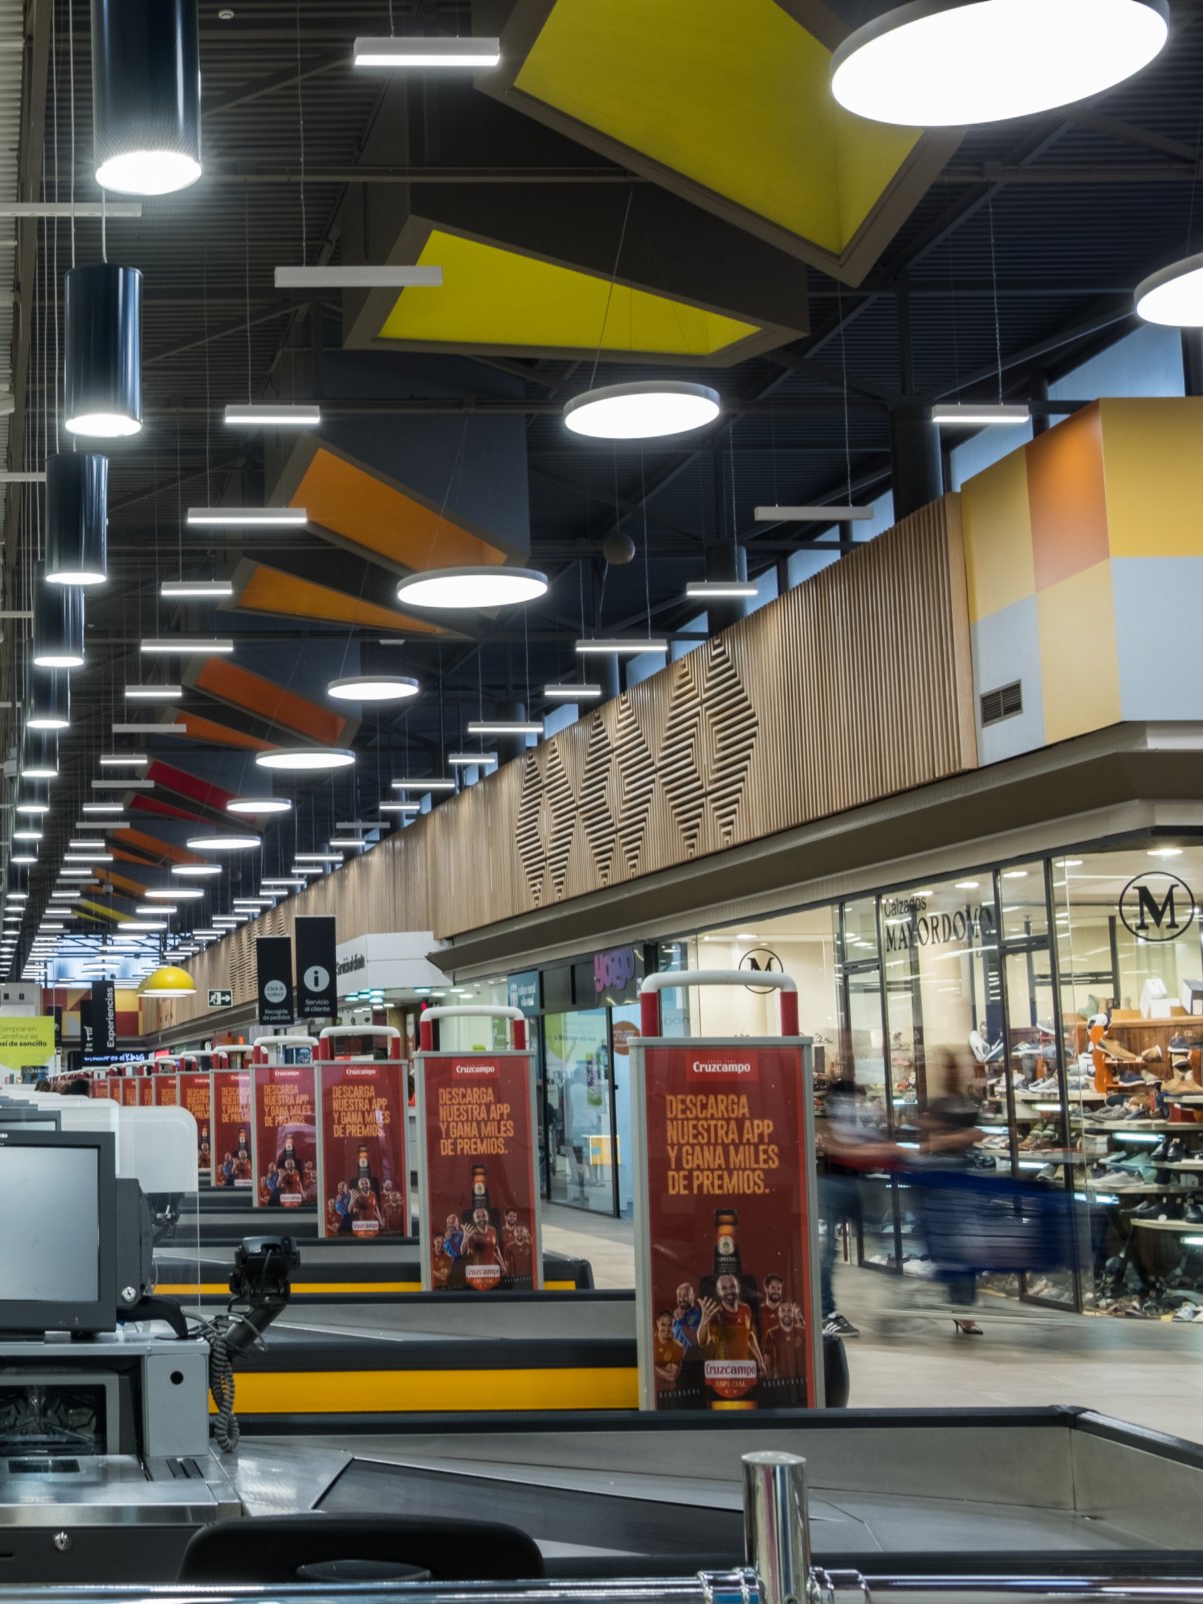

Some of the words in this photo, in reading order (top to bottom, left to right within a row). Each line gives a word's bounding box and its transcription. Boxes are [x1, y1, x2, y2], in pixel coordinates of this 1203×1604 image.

[884, 895, 926, 918] Calzados
[1132, 884, 1180, 930] M
[106, 987, 116, 1048] Experiencias
[456, 1066, 495, 1075] Cruzcampo
[693, 1061, 751, 1074] Cruzcampo
[264, 1084, 298, 1095] DESCARGA
[333, 1085, 375, 1099] DESCARGA
[439, 1088, 494, 1104] DESCARGA
[264, 1095, 295, 1105] NUESTRA
[296, 1094, 309, 1105] APP
[333, 1099, 370, 1112] NUESTRA
[372, 1098, 388, 1111] APP
[666, 1094, 749, 1119] DESCARGA
[271, 1105, 289, 1115] GANA
[439, 1105, 487, 1121] NUESTRA
[490, 1104, 510, 1120] APP
[265, 1116, 274, 1127] DE
[333, 1112, 339, 1125] Y
[341, 1111, 363, 1124] GANA
[334, 1125, 345, 1137] DE
[346, 1124, 385, 1137] PREMIOS.
[440, 1123, 447, 1138] Y
[450, 1122, 478, 1137] GANA
[481, 1120, 514, 1137] MILES
[666, 1120, 741, 1144] NUESTRA
[742, 1119, 773, 1144] APP
[440, 1139, 455, 1155] DE
[457, 1138, 508, 1155] PREMIOS.
[667, 1146, 678, 1169] Y
[682, 1145, 725, 1169] GANA
[730, 1145, 779, 1169] MILES
[668, 1171, 689, 1195] DE
[693, 1170, 770, 1195] PREMIOS.
[706, 1362, 756, 1377] Cruzcampo
